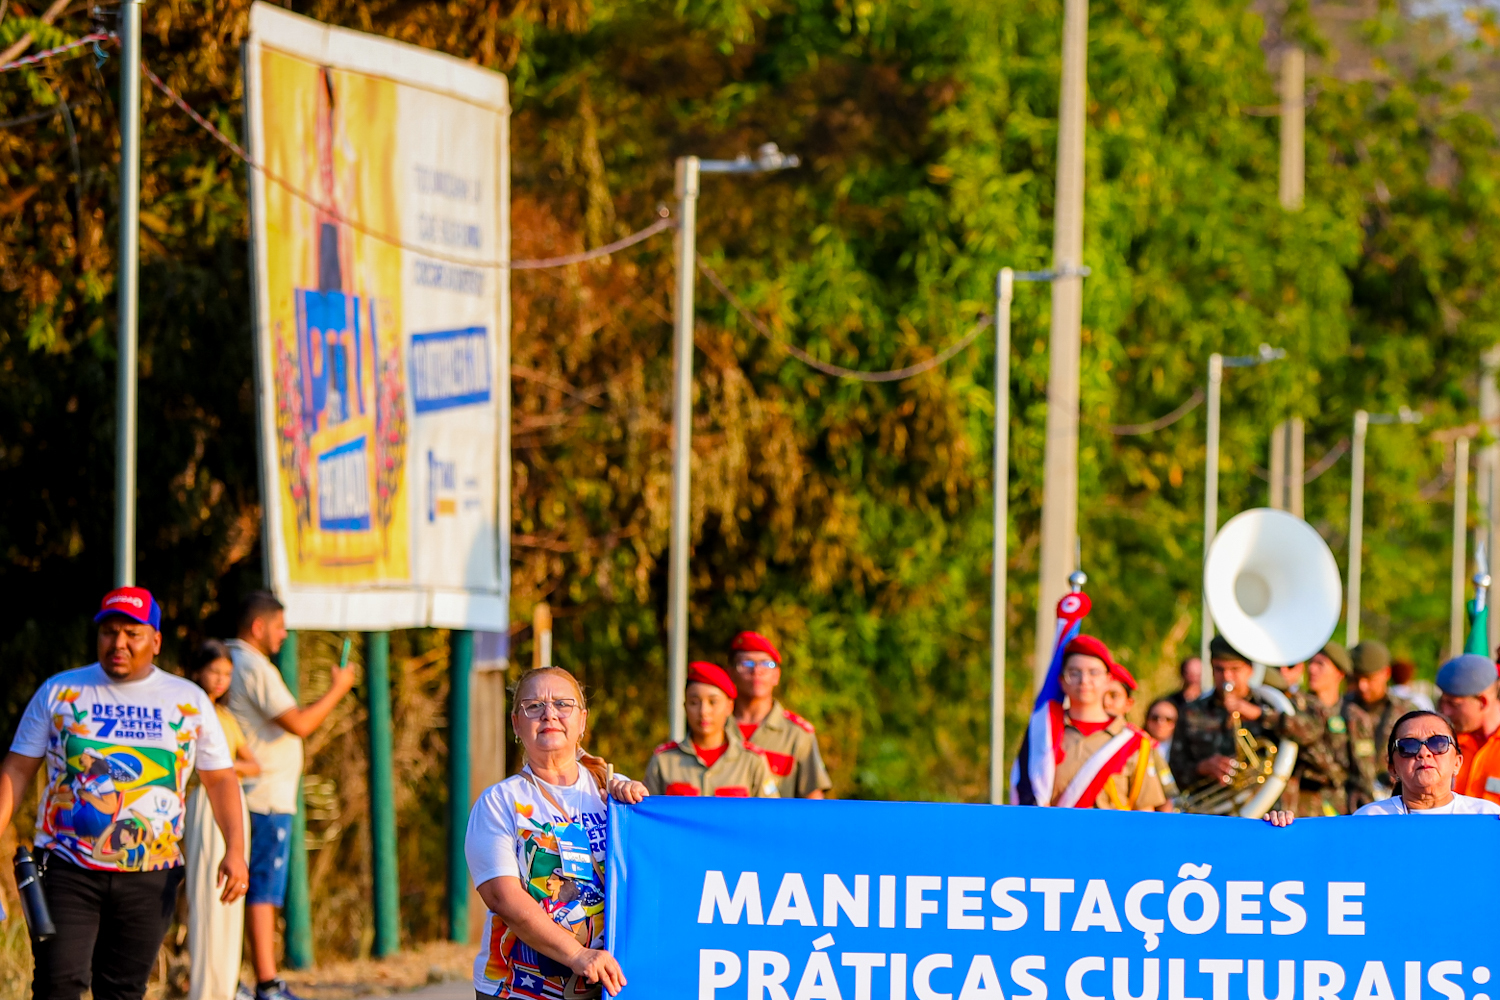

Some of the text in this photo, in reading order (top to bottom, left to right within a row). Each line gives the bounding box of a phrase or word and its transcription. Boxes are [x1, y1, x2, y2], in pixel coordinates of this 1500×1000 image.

[92, 704, 162, 721] DESFILE
[92, 717, 162, 738] 7 SETEM
[115, 730, 145, 739] BRO
[698, 863, 1365, 952] MANIFESTAÇÕES E
